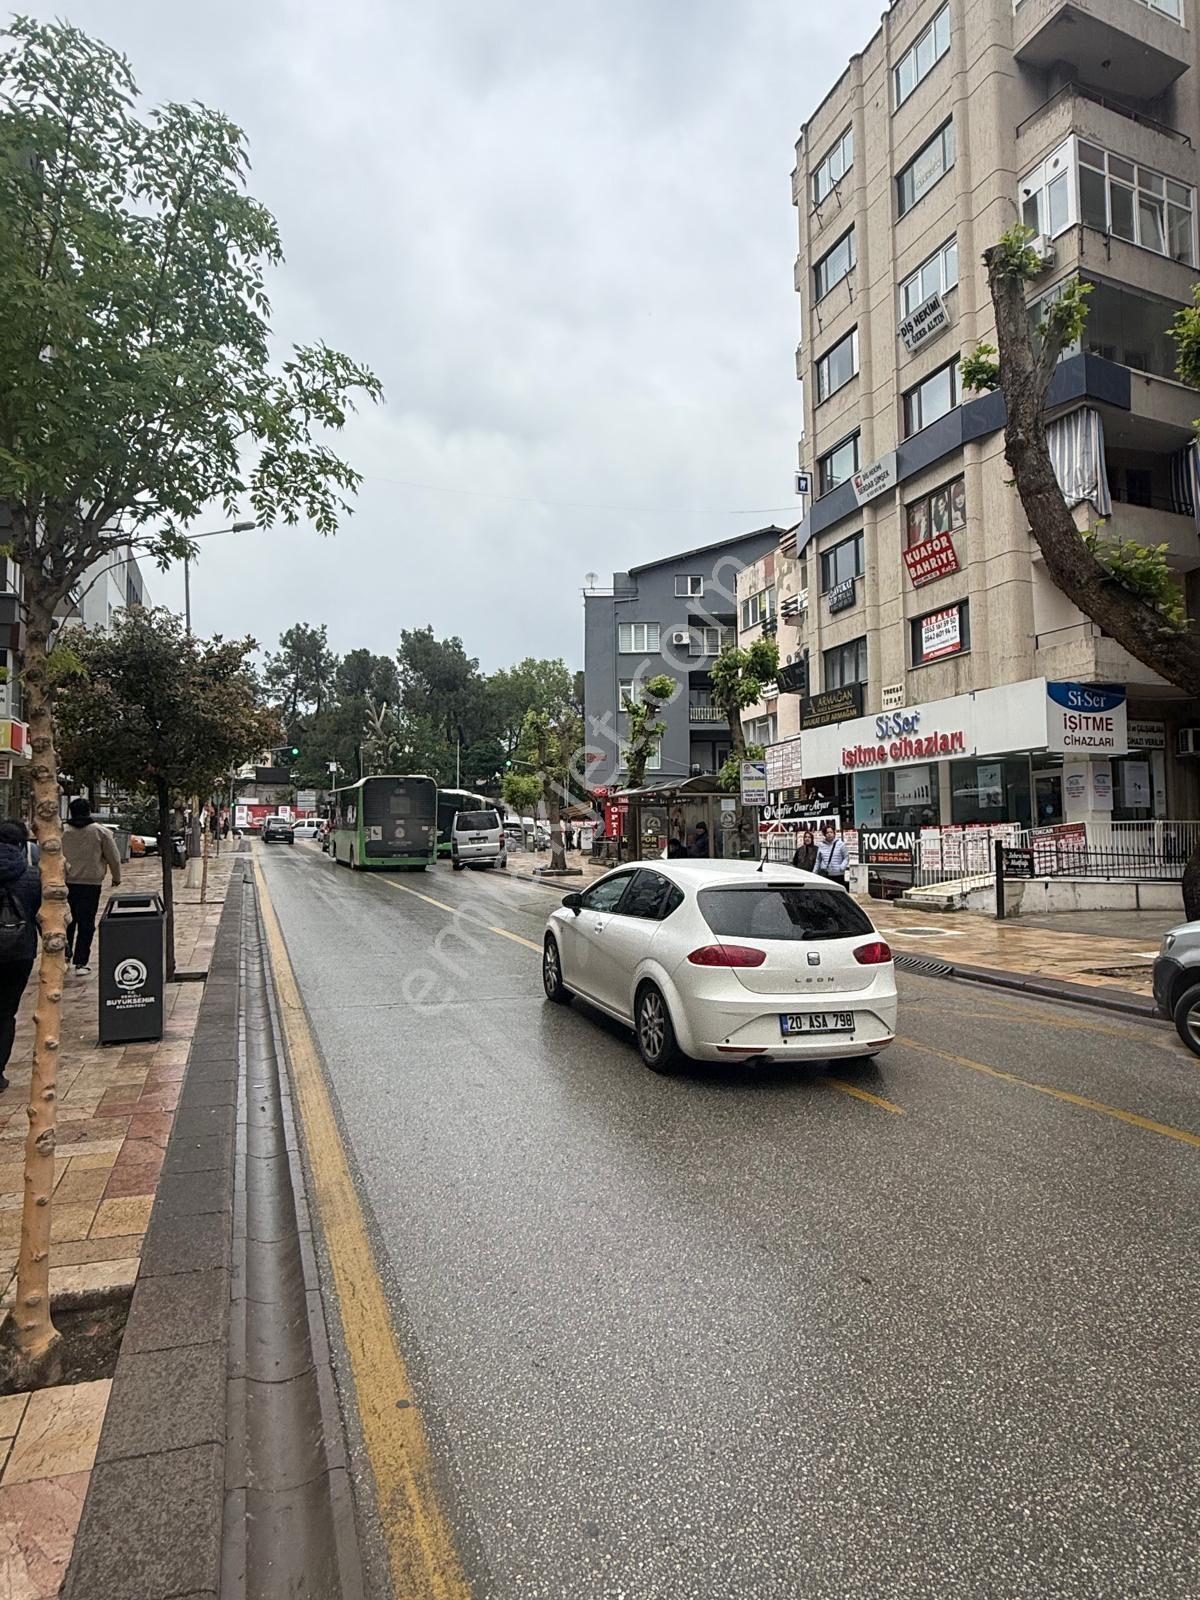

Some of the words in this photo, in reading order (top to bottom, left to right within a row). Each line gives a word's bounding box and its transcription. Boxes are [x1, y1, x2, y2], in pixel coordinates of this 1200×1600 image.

[900, 321, 915, 338] DİŞ
[905, 531, 950, 564] KUAFÖR
[910, 549, 956, 579] BAHRİYE
[922, 606, 960, 628] KIRALIK
[818, 688, 853, 707] ARMAĞAN
[1063, 713, 1114, 733] İŞİTME
[1063, 734, 1115, 747] CİHAZLARI
[862, 831, 916, 850] TOKCAN
[788, 1015, 803, 1030] 20
[809, 1014, 829, 1029] ASA
[832, 1013, 853, 1028] 798
